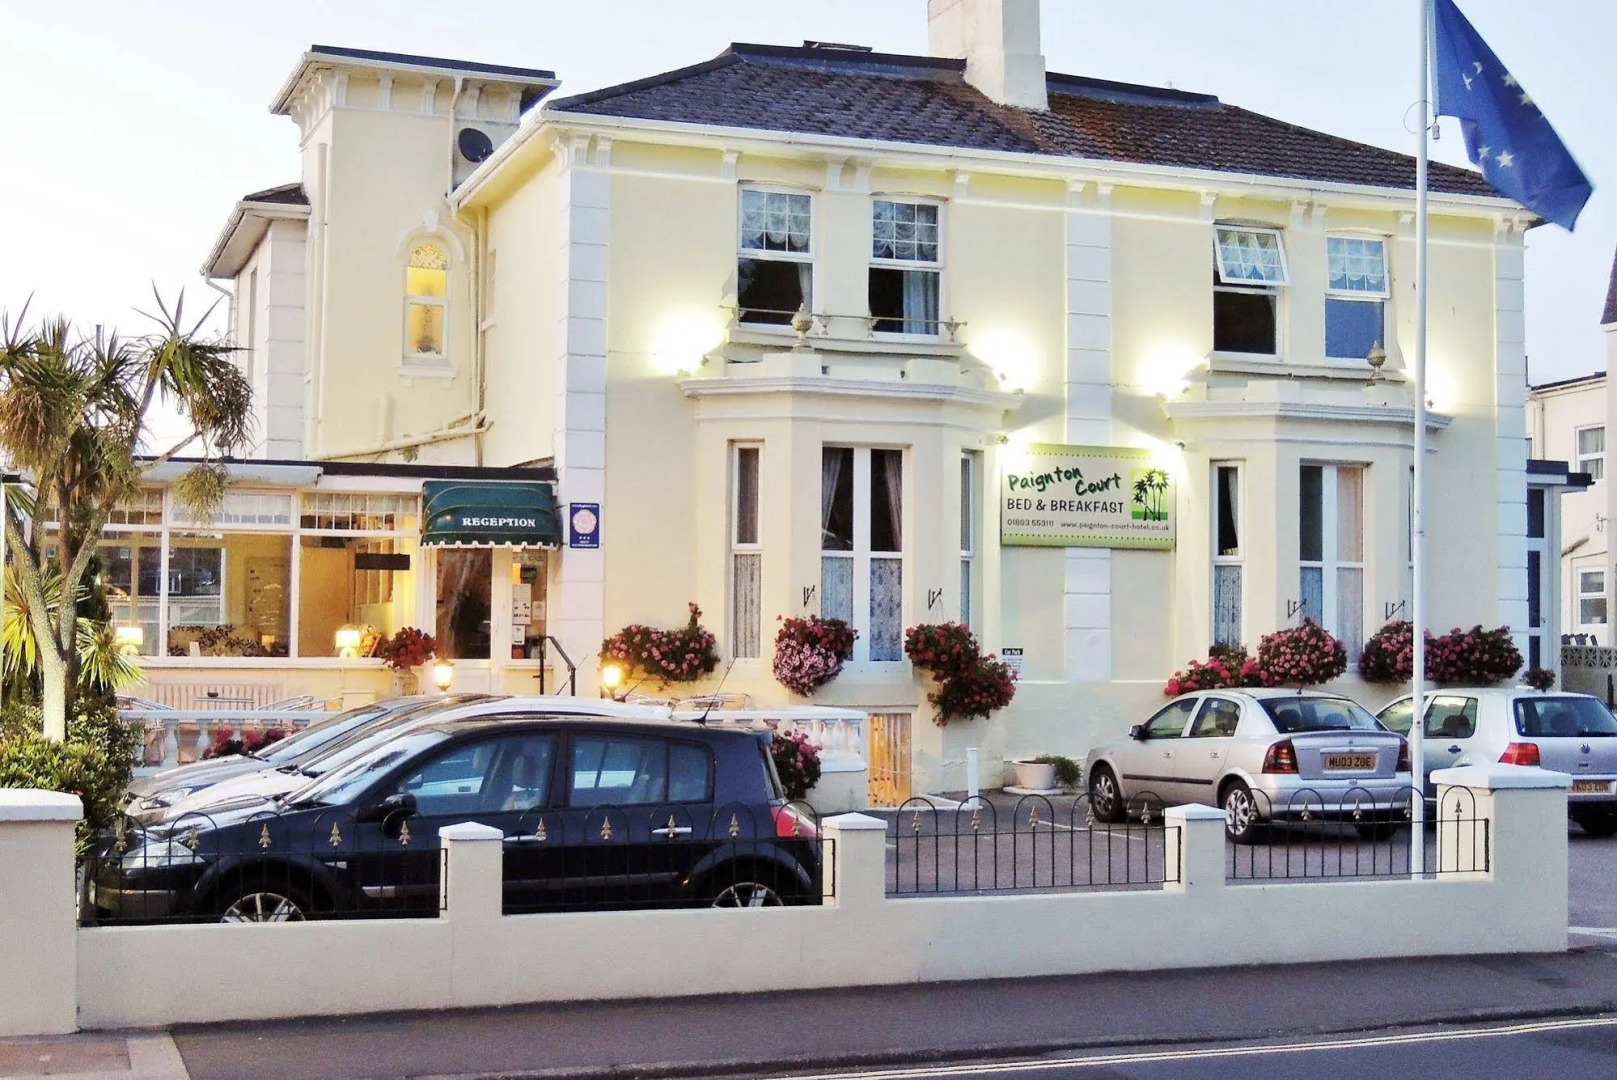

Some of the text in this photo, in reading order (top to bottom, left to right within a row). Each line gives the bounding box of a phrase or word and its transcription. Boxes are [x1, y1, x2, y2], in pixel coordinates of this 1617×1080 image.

[1007, 465, 1083, 492] Paignton
[1075, 473, 1122, 496] Court
[1007, 498, 1124, 514] BED & BREAKFAST
[462, 517, 536, 528] RECEPTION
[1007, 518, 1169, 531] 01803 553111 www.paignton-court-hotel.co.uk
